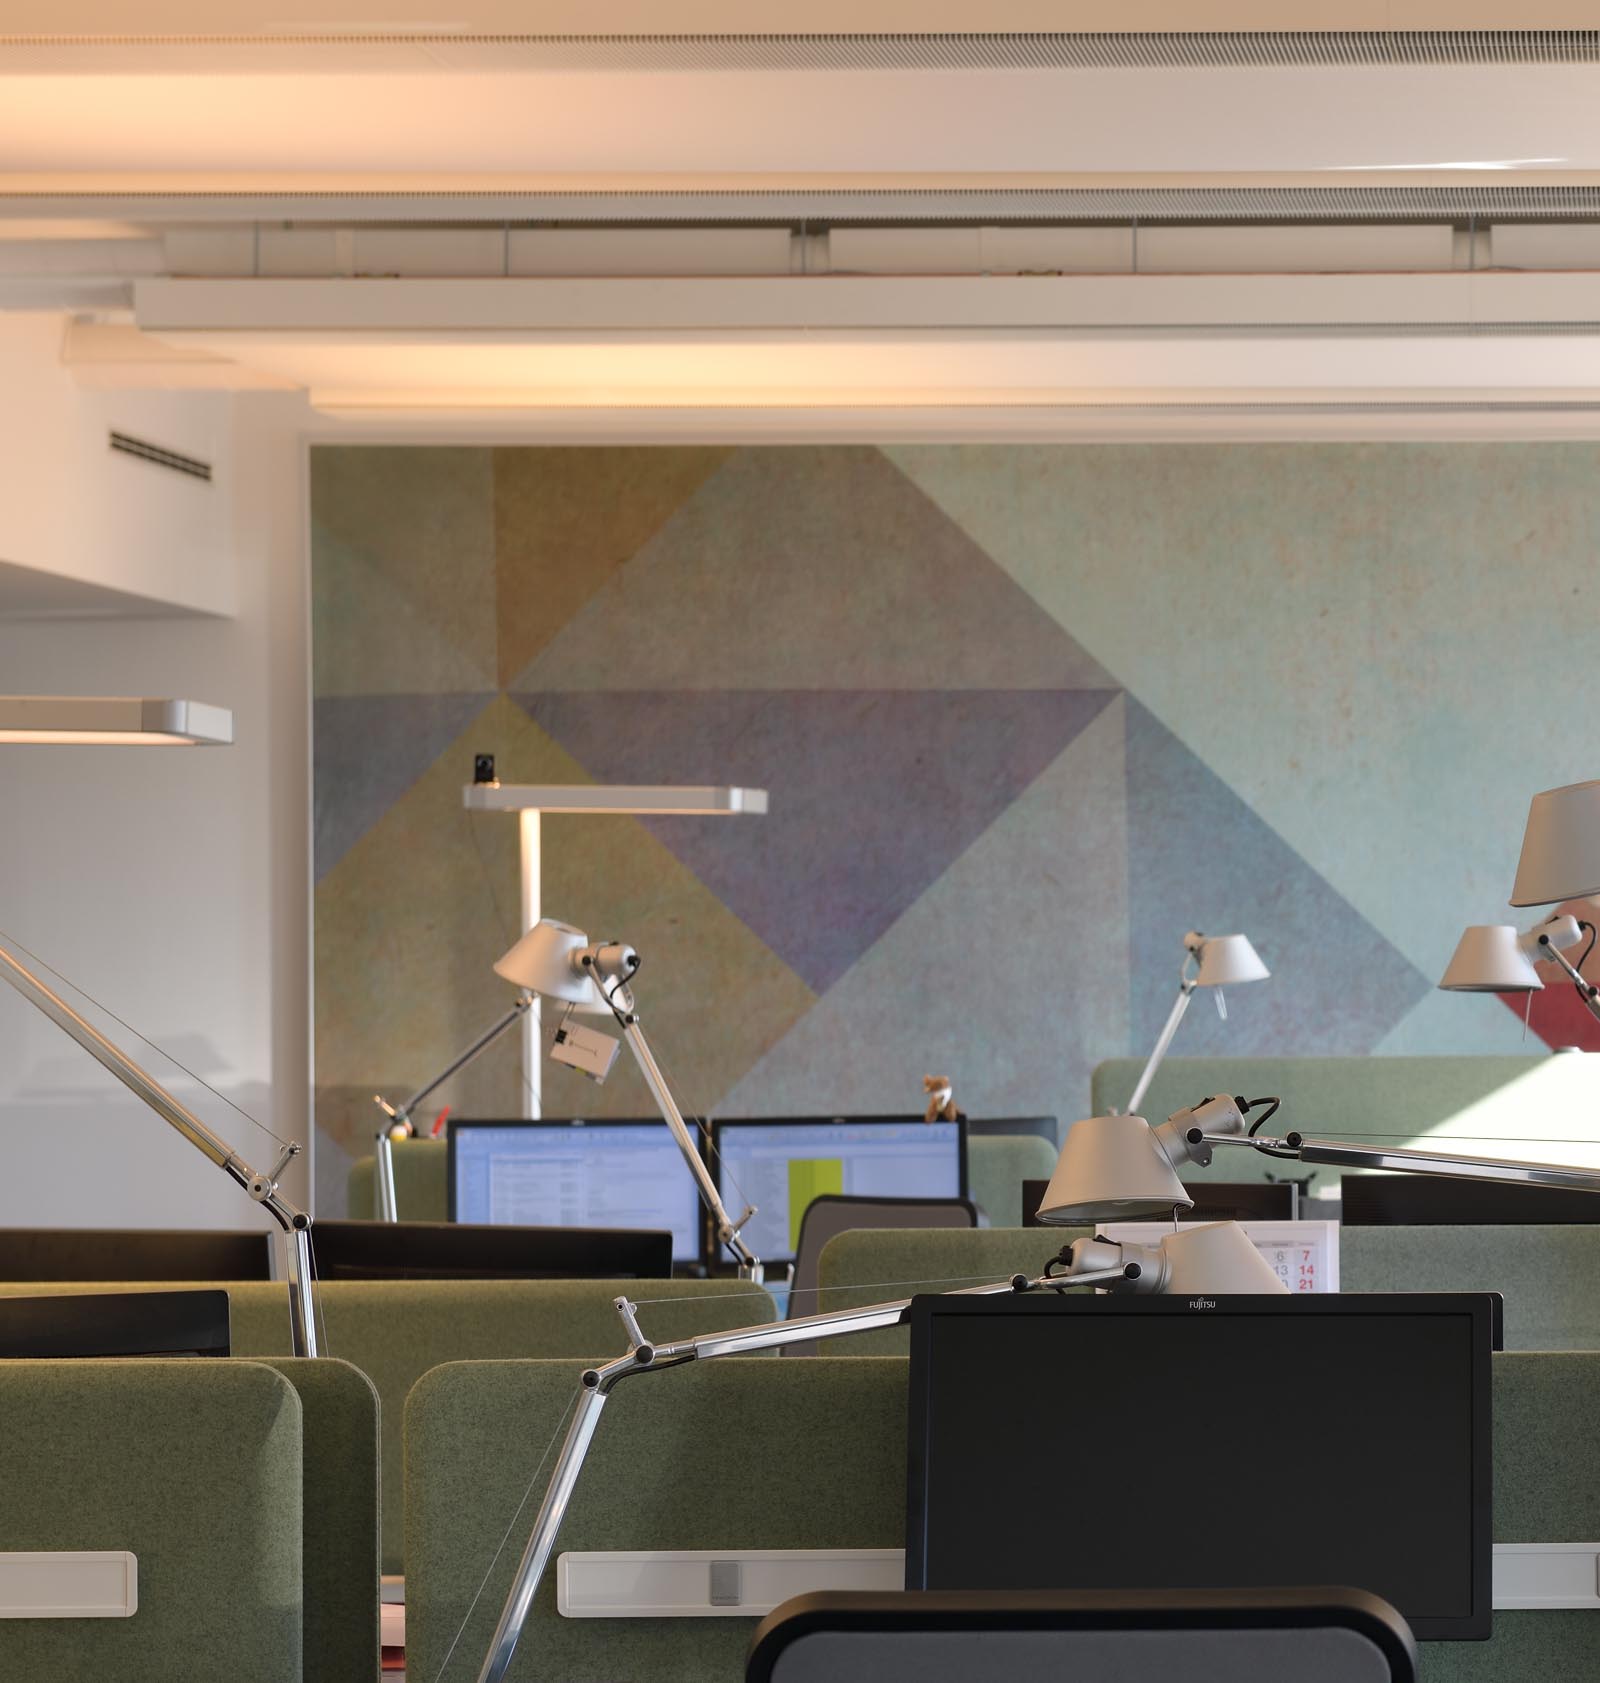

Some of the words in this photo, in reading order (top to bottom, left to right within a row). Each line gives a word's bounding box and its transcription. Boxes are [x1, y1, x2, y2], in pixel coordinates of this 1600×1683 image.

[1276, 1251, 1285, 1261] 6
[1303, 1250, 1310, 1261] 7
[1274, 1264, 1288, 1275] 13
[1299, 1264, 1314, 1275] 14
[1299, 1279, 1313, 1290] 21
[1189, 1297, 1216, 1310] FUJITSU
